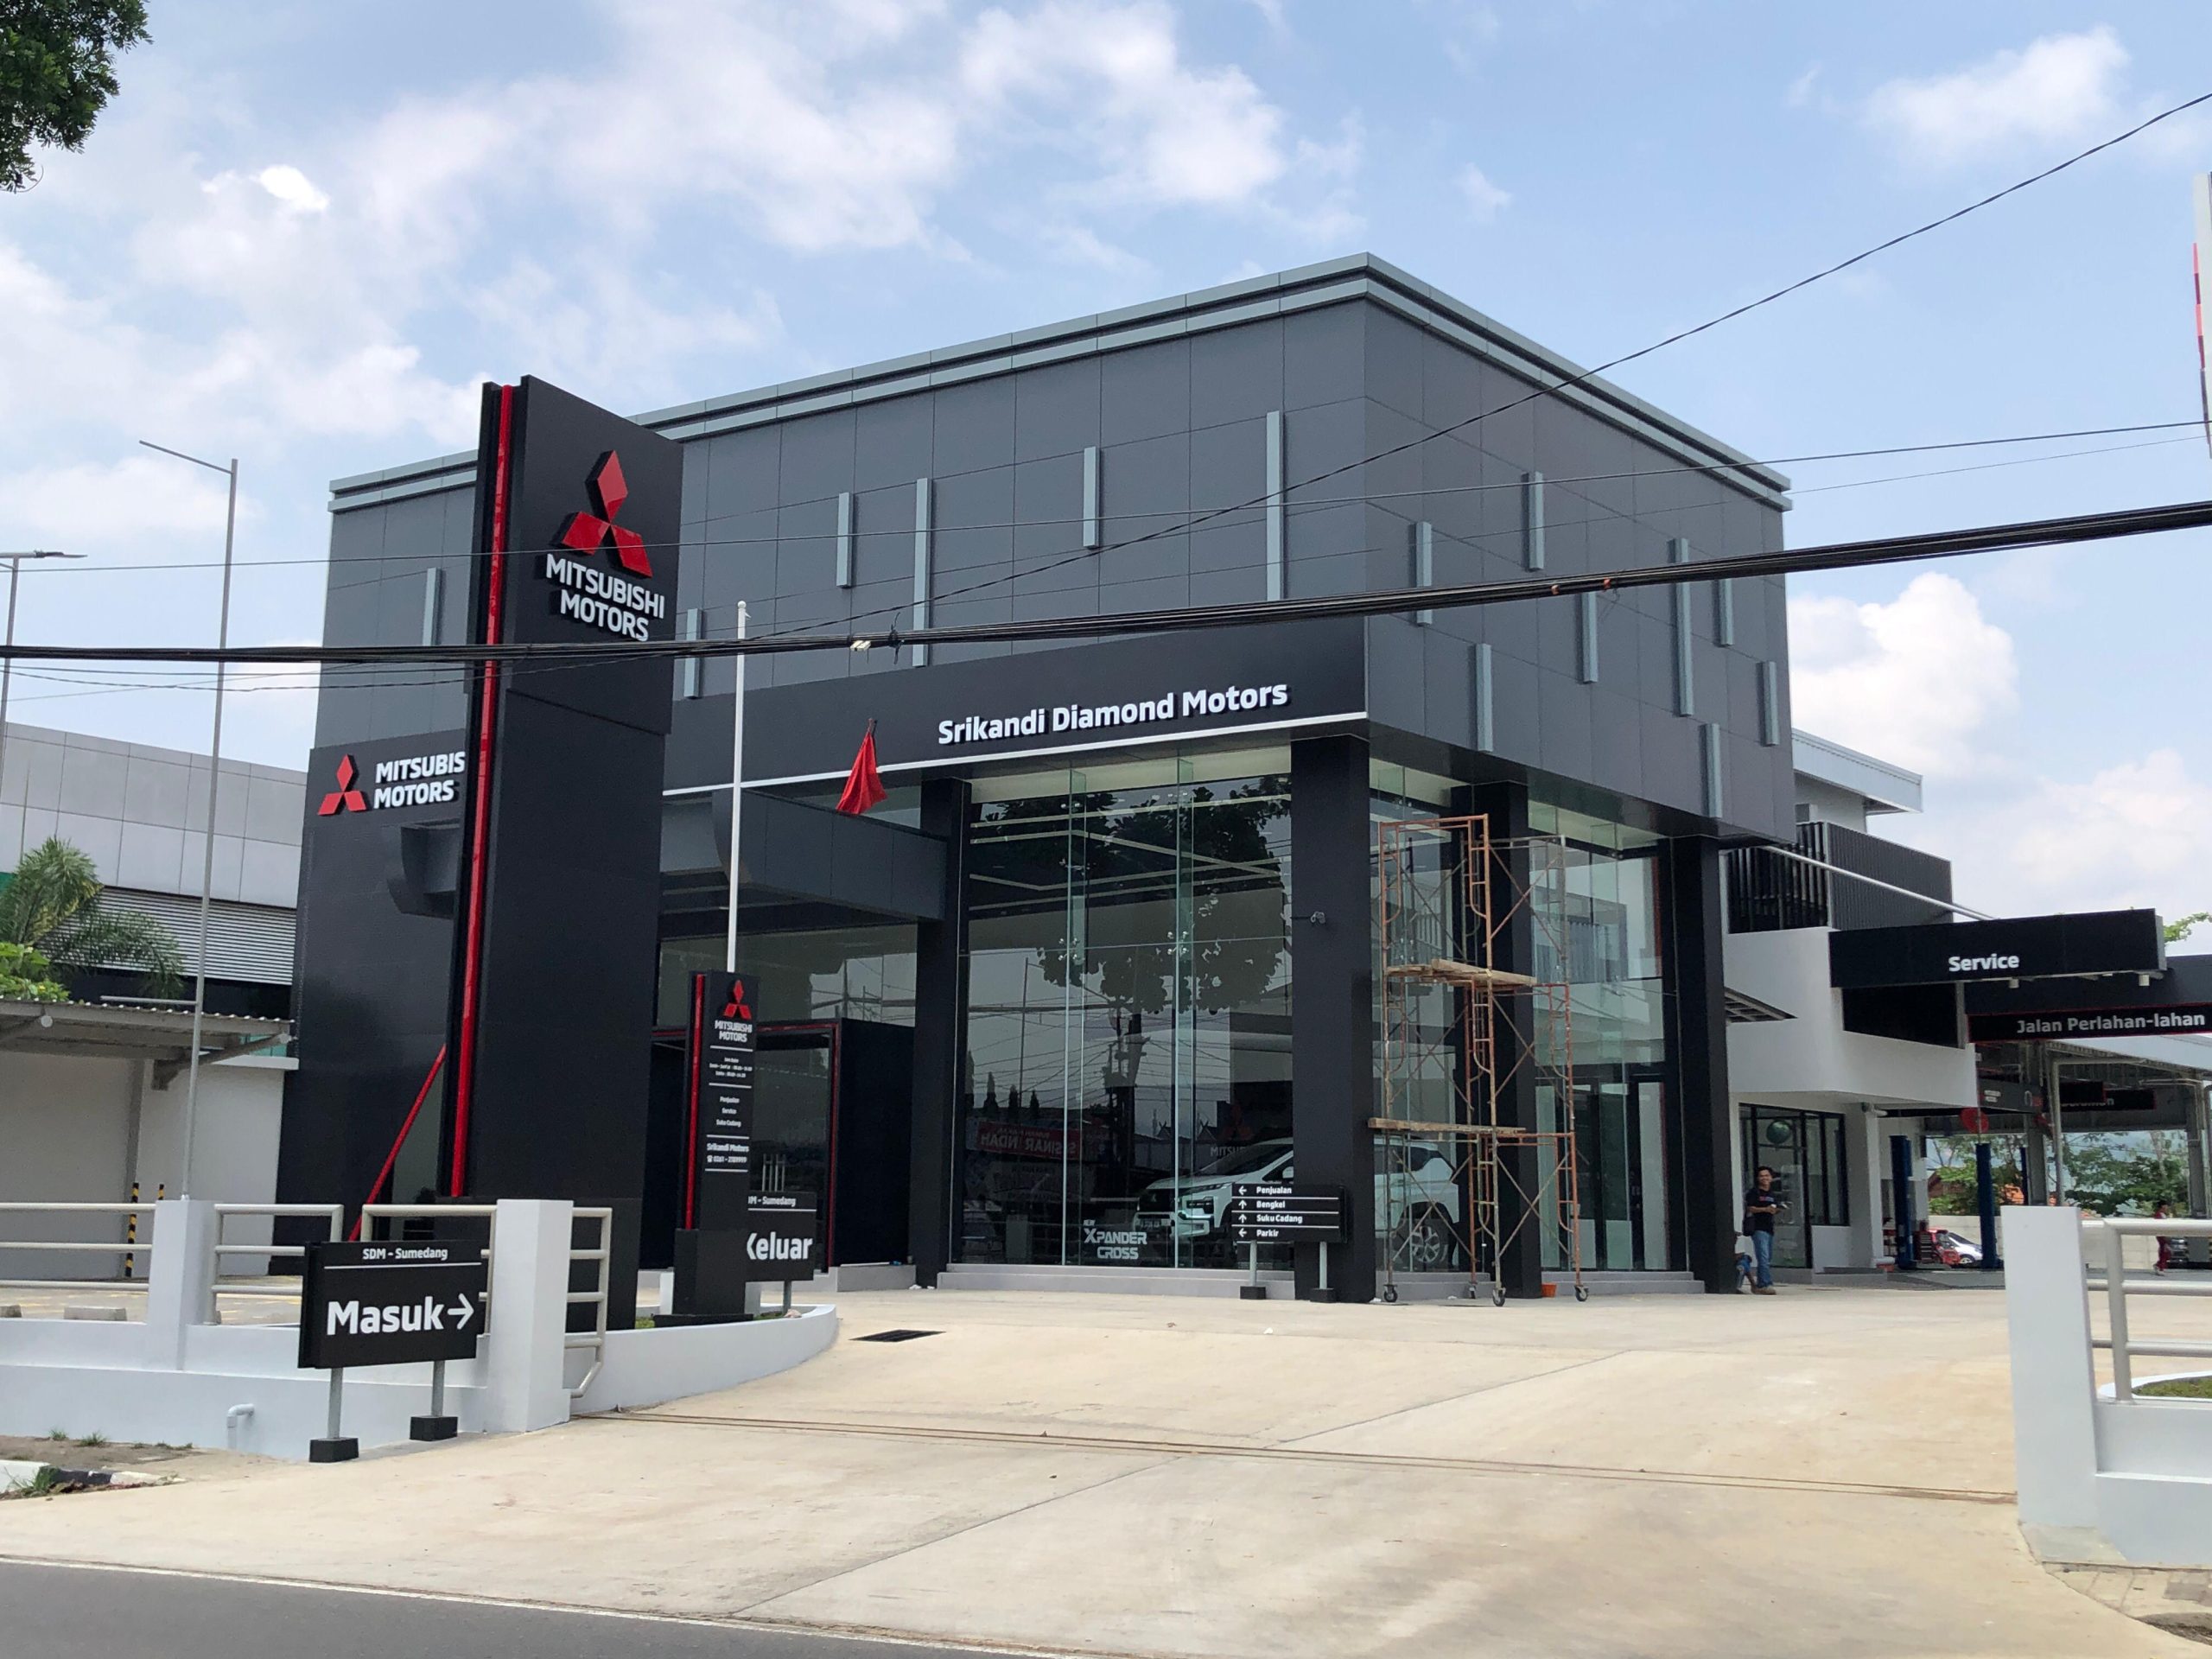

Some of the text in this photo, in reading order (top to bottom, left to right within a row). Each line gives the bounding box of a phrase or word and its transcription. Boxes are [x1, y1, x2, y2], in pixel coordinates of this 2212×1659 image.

[546, 553, 665, 619] MITSUBISHI
[561, 589, 649, 642] MOTORS
[938, 684, 1287, 744] Srikandi Diamond Motors
[375, 751, 466, 784] MITSUBIS
[373, 779, 454, 810] MOTORS
[1948, 953, 2019, 972] Service
[714, 1020, 753, 1034] MITSUBISHI
[2017, 1012, 2205, 1033] Jalan Perlahan-lahan
[718, 1030, 748, 1043] MOTORS
[1256, 1185, 1293, 1196] Penjualan
[762, 1196, 797, 1208] Sumedang
[1256, 1200, 1286, 1210] Bengkel
[1256, 1214, 1303, 1224] Suku Cadang
[1084, 1228, 1147, 1245] XPANDER
[1256, 1229, 1280, 1237] Parkir
[362, 1248, 386, 1260] SDM
[395, 1247, 448, 1261] Sumedang
[1096, 1246, 1139, 1260] CROSS
[327, 1296, 444, 1336] Masuk
